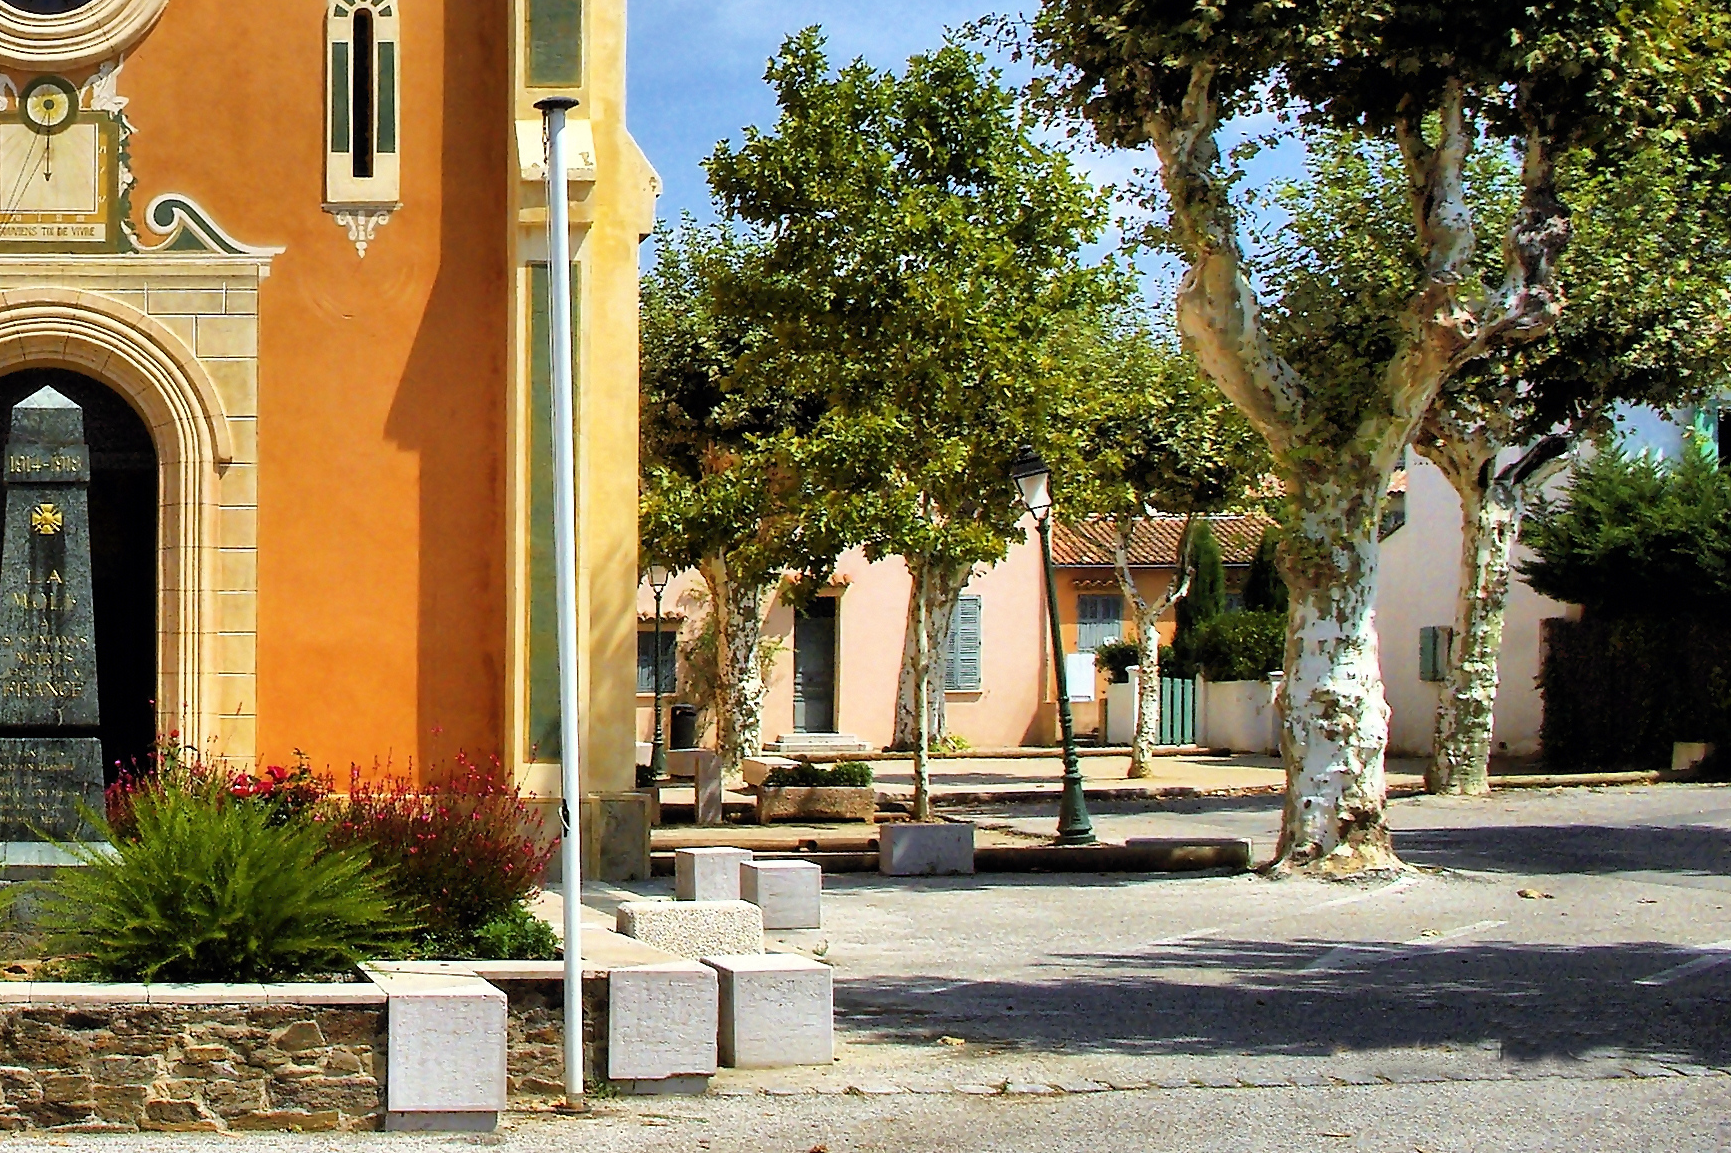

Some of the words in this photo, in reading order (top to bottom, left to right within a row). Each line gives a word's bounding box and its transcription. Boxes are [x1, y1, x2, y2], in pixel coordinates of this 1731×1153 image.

[41, 227, 54, 237] TOI
[57, 227, 68, 237] DE
[71, 227, 95, 237] VIVRE
[10, 454, 84, 473] 1914-1918
[27, 569, 63, 584] LA
[2, 680, 86, 698] FRANCE
